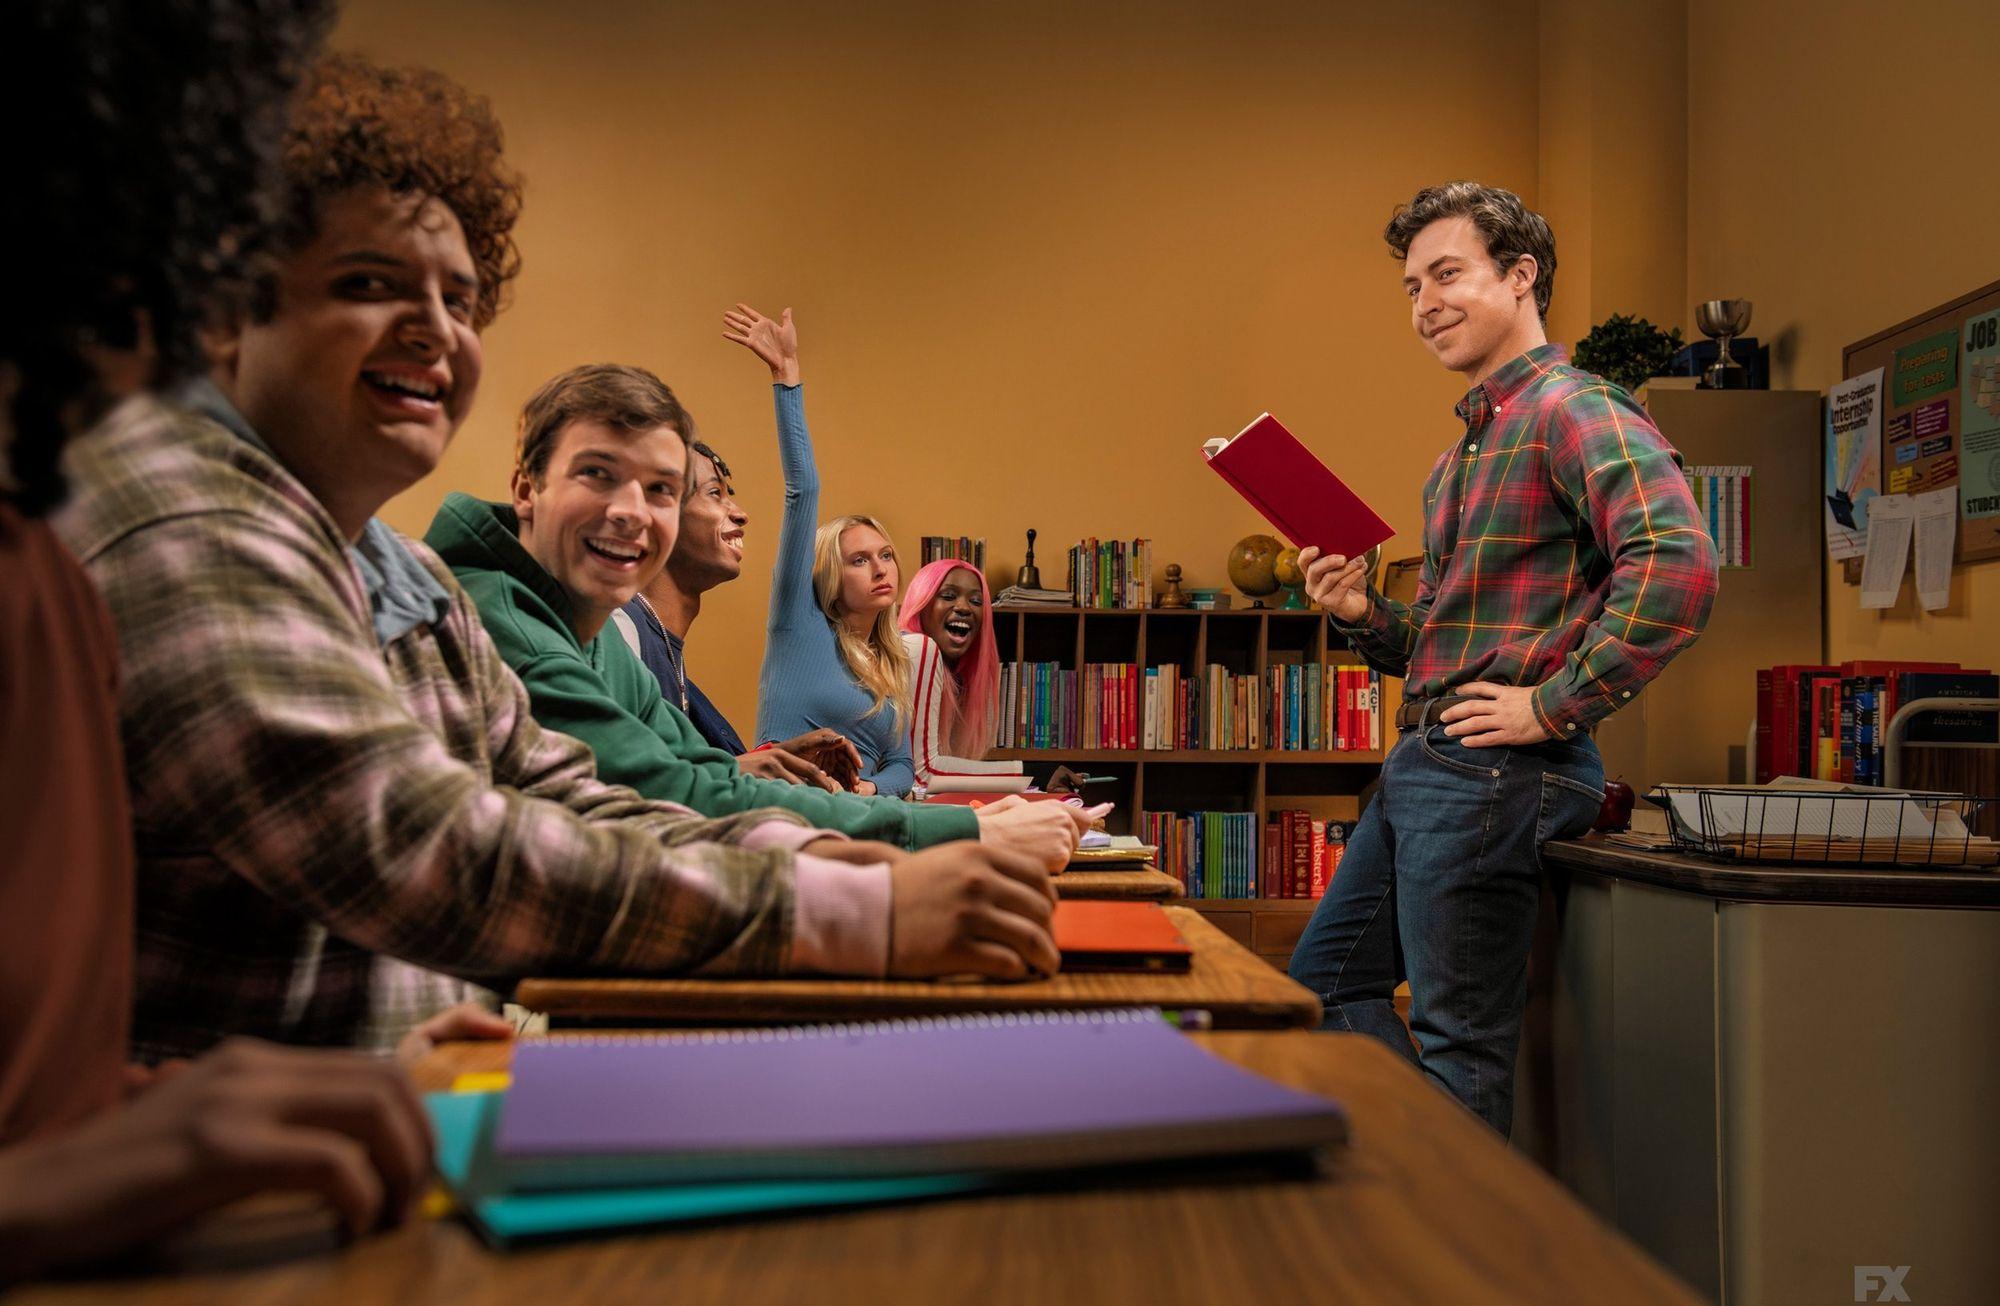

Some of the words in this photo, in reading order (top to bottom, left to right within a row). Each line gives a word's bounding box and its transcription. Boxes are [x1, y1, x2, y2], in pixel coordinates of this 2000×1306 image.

[1966, 317, 1997, 351] JOB
[1901, 346, 1948, 372] Preparing
[1904, 379, 1919, 394] for
[1832, 397, 1874, 425] Internship
[1967, 494, 2000, 514] STUDEN
[1370, 687, 1378, 714] ACT
[1313, 834, 1325, 885] Webster's
